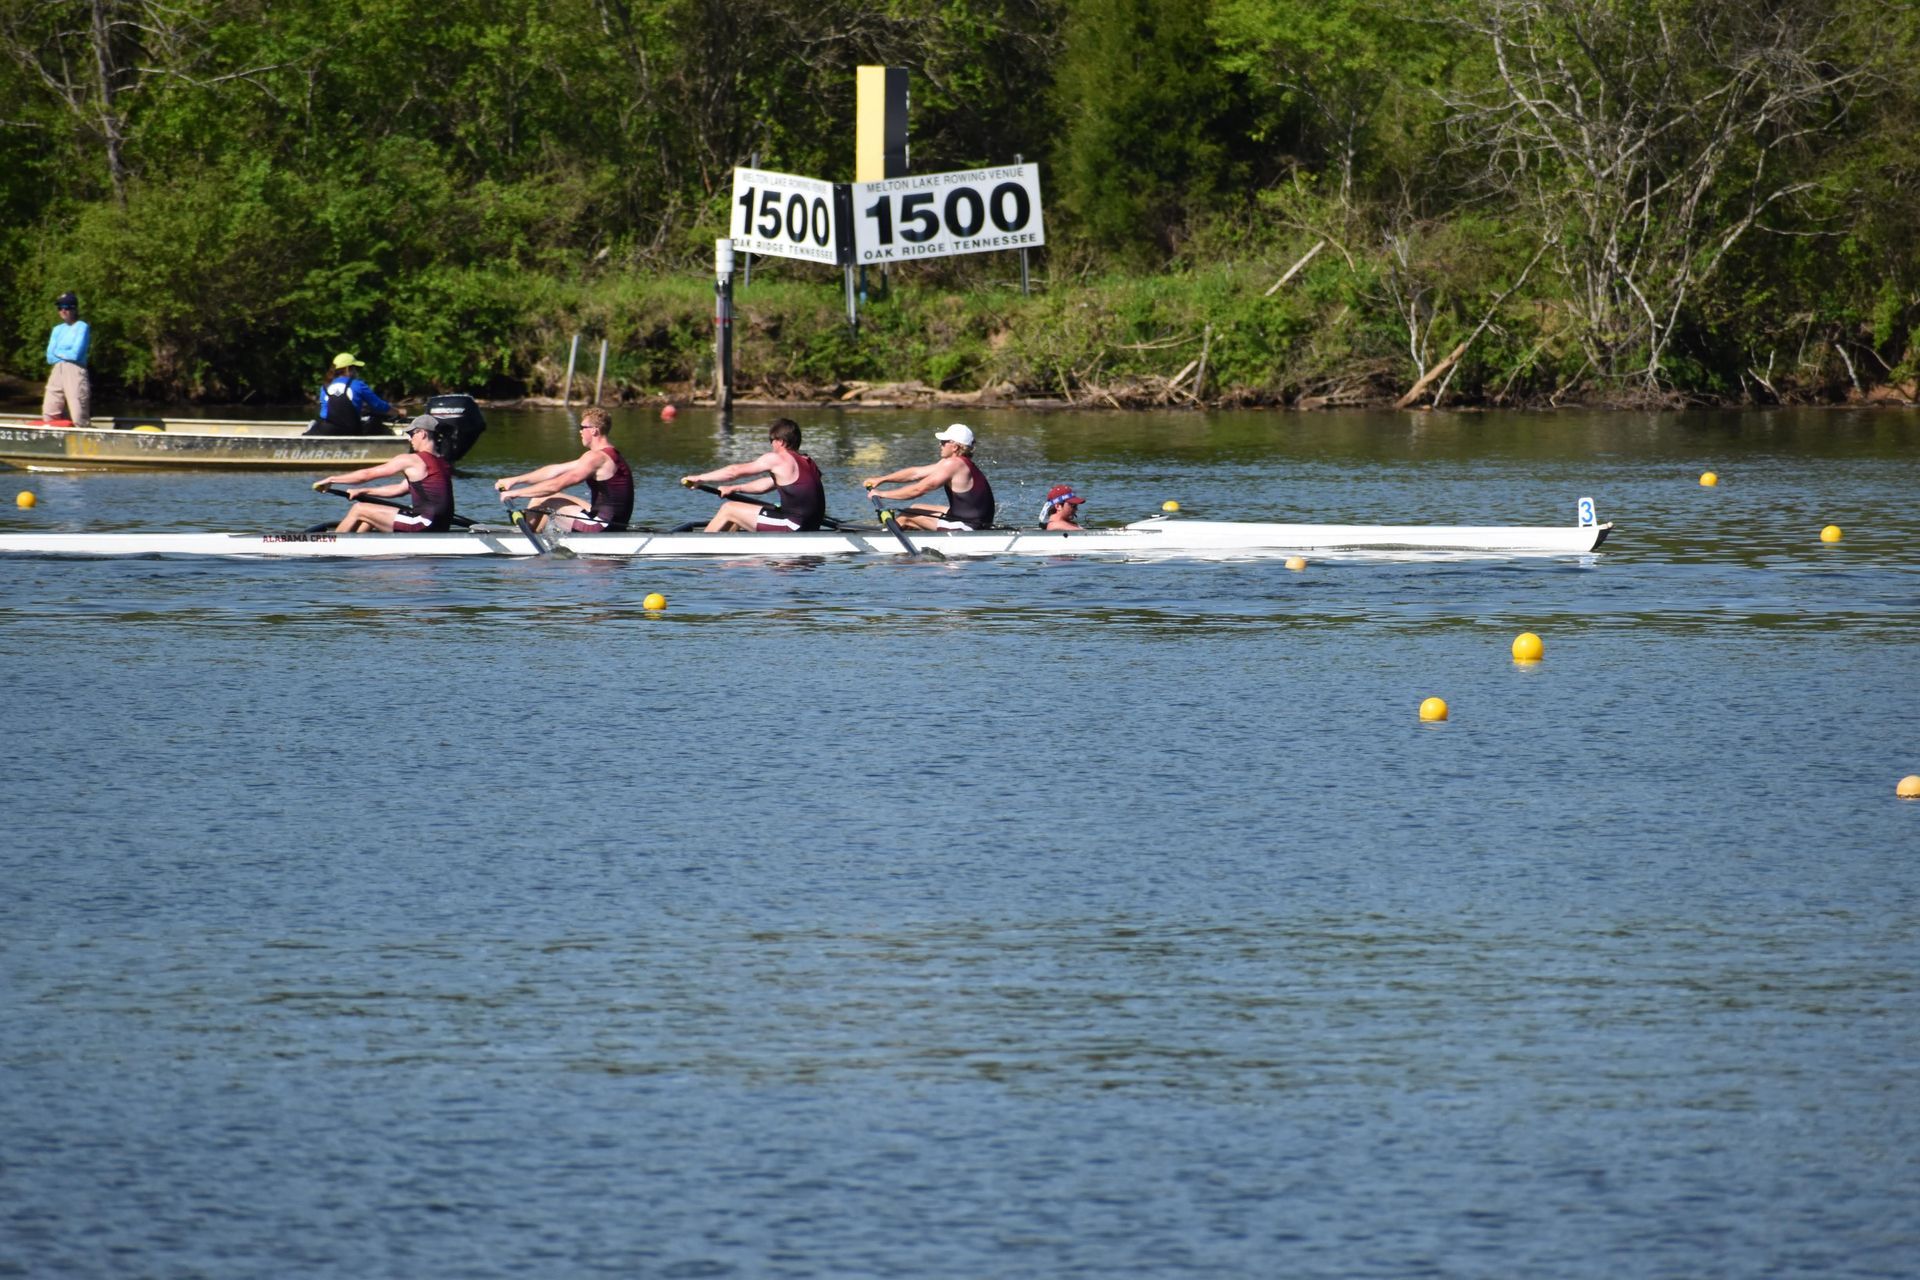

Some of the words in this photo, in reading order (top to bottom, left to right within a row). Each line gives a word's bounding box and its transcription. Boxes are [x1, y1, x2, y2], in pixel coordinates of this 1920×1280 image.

[771, 176, 787, 188] LAKE
[866, 181, 911, 193] MELTON
[913, 176, 941, 188] LAKE
[944, 171, 986, 185] ROWING
[988, 168, 1024, 179] VENUE
[739, 187, 830, 247] 1500
[865, 182, 1030, 246] 1500
[757, 241, 784, 252] RIDGE
[789, 245, 833, 260] TENNESSEE
[864, 248, 894, 260] OAK
[902, 243, 945, 256] RIDGE
[954, 233, 1037, 250] TENNESSEE
[1580, 501, 1593, 523] 3
[263, 534, 308, 543] ALABAMA
[310, 534, 337, 543] CREW
